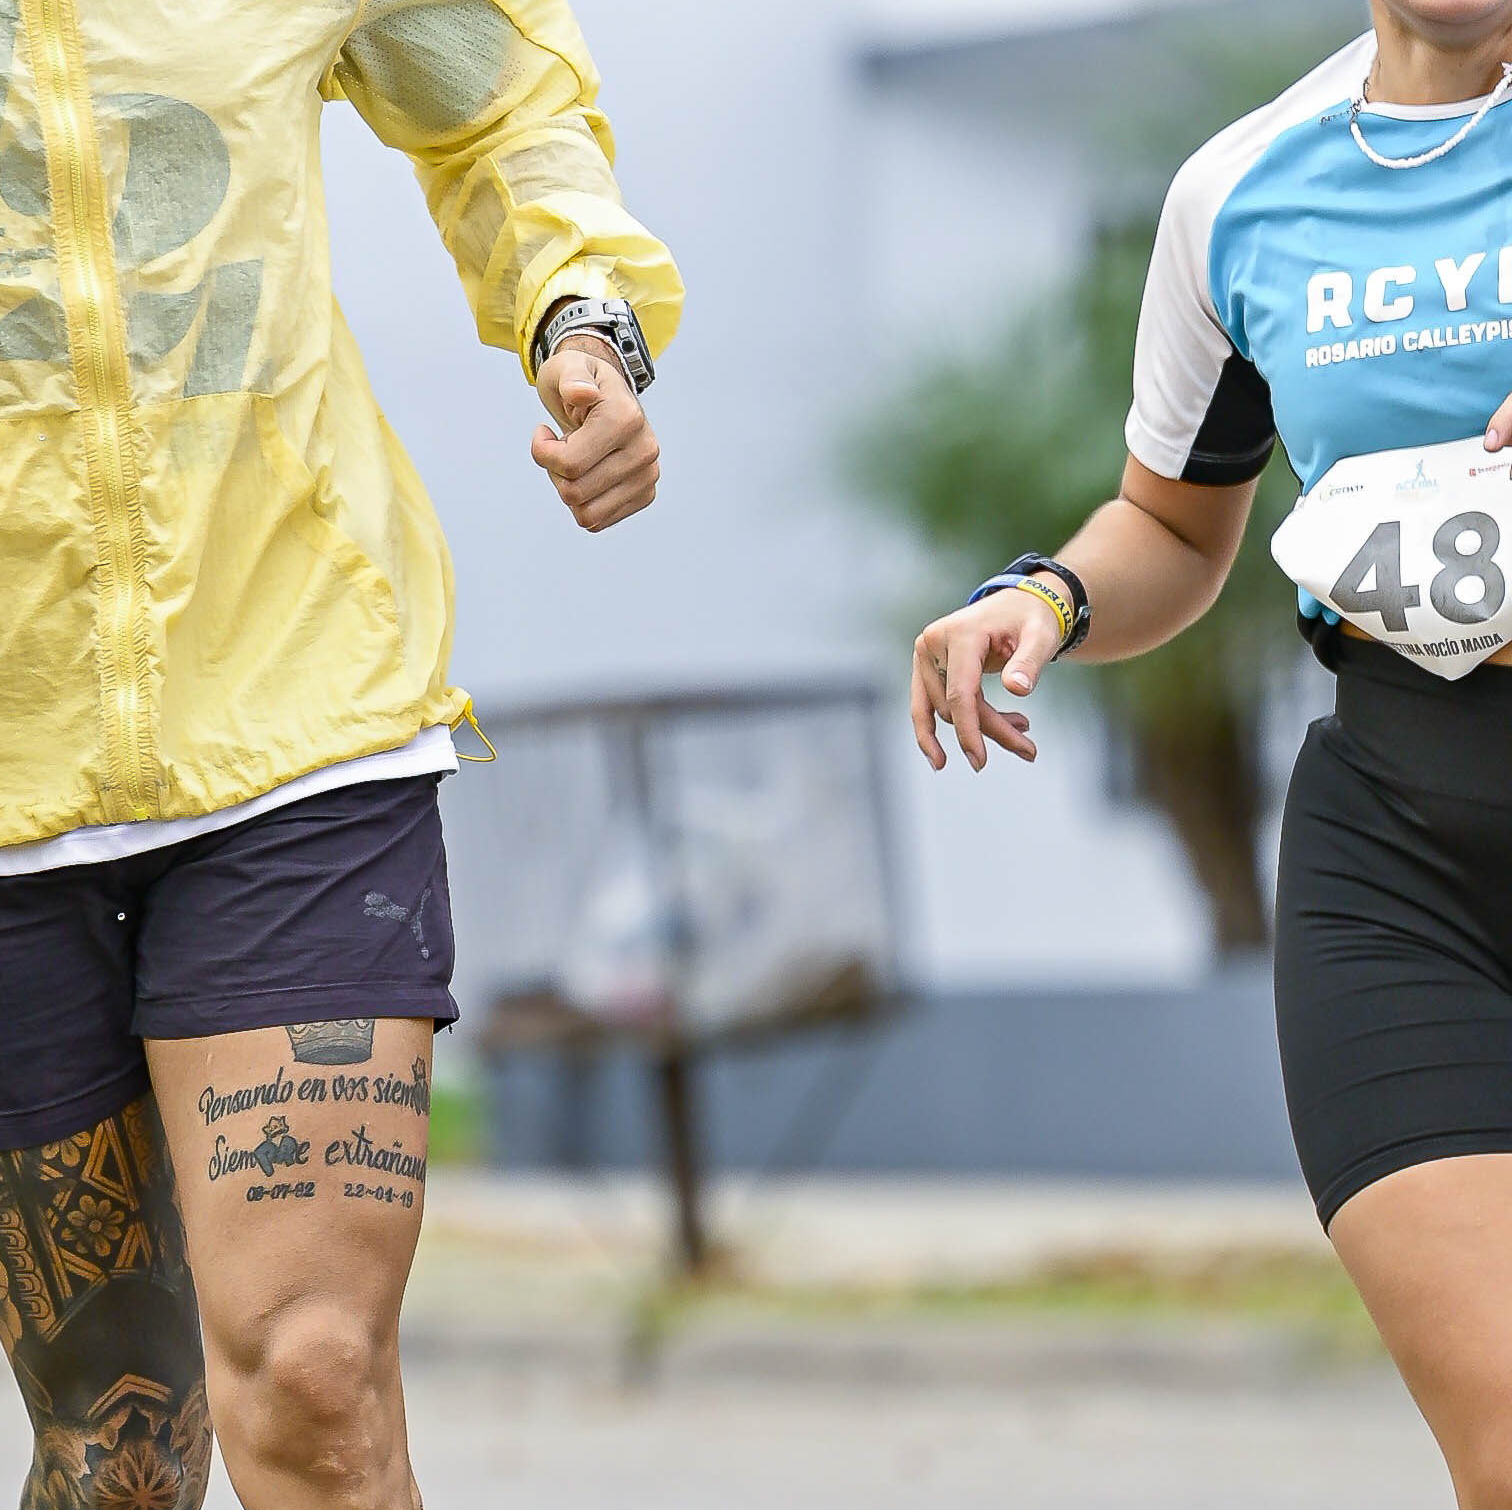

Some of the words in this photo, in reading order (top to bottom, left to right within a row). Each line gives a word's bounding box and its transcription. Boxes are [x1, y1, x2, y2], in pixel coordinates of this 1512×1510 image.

[1305, 334, 1397, 368] ROSARIO
[1402, 318, 1512, 352] CALLEYPI
[1329, 511, 1506, 632] 48
[1423, 638, 1460, 658] ROCÍO
[1461, 633, 1504, 654] MAIDA
[199, 1066, 294, 1126] Pensando
[298, 1078, 327, 1102] en
[333, 1074, 369, 1102] vos
